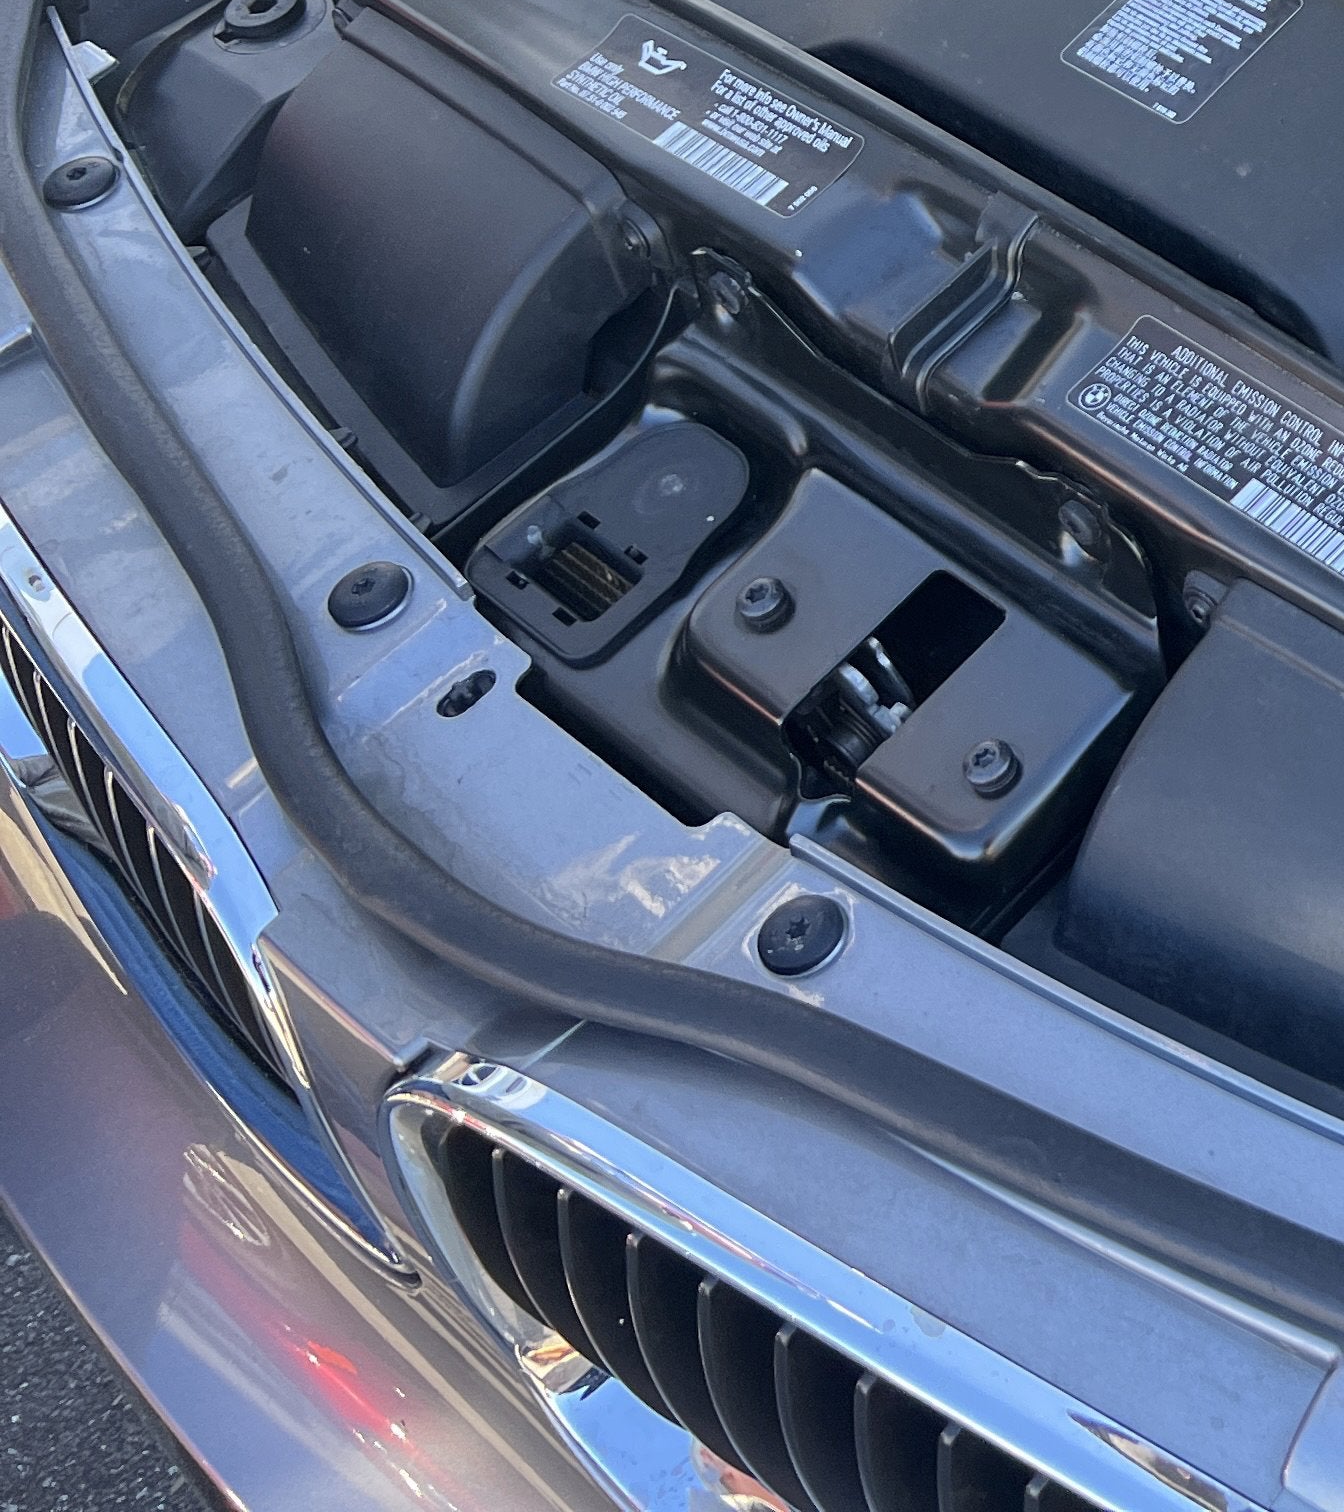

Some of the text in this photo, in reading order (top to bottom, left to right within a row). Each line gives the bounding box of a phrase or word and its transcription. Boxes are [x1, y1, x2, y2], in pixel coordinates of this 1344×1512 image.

[565, 69, 614, 98] SYNTHETIC
[607, 91, 626, 106] OIL
[597, 71, 624, 89] HIGH
[617, 82, 681, 121] PERFORMANCE
[710, 79, 831, 153] For a list of other approved oils
[719, 68, 854, 149] For more info see Owner's Manual
[1094, 365, 1150, 403] PROPERTIES
[1149, 398, 1164, 412] IS
[1161, 408, 1173, 419] A
[1174, 414, 1226, 451] VIOLATION
[1224, 446, 1242, 459] OF
[1239, 457, 1262, 474] AIR
[1259, 468, 1314, 508] POLLUTION
[1105, 356, 1151, 388] CHANGING
[1150, 383, 1167, 397] TO
[1164, 393, 1176, 405] A
[1175, 399, 1224, 433] RADIATOR
[1223, 429, 1267, 459] WITHOUT
[1264, 455, 1326, 497] EQUIVALENT
[1106, 402, 1135, 424] VEHICLE
[1132, 419, 1166, 444] EMISSION
[1163, 438, 1193, 462] CONTROL
[1113, 393, 1141, 412] DIRECT
[1159, 421, 1199, 450] REDUCTION
[1196, 445, 1234, 472] RADIATOR
[1117, 346, 1144, 366] THAT
[1141, 362, 1156, 375] IS
[1154, 371, 1173, 385] AN
[1170, 380, 1215, 410] ELEMENT
[1212, 406, 1230, 419] OF
[1229, 416, 1251, 434] THE
[1250, 429, 1293, 460] VEHICLE
[1290, 454, 1340, 489] EMISSION
[1126, 335, 1150, 355] THIS
[1149, 349, 1190, 379] VEHICLE
[1188, 374, 1203, 388] IS
[1201, 382, 1247, 415] EQUIPPED
[1247, 410, 1274, 433] WITH
[1272, 427, 1292, 443] AN
[1290, 437, 1323, 462] OZONE
[1171, 345, 1229, 388] ADDITIONAL
[1231, 380, 1282, 418] EMISSION
[1280, 410, 1323, 447] CONTROL
